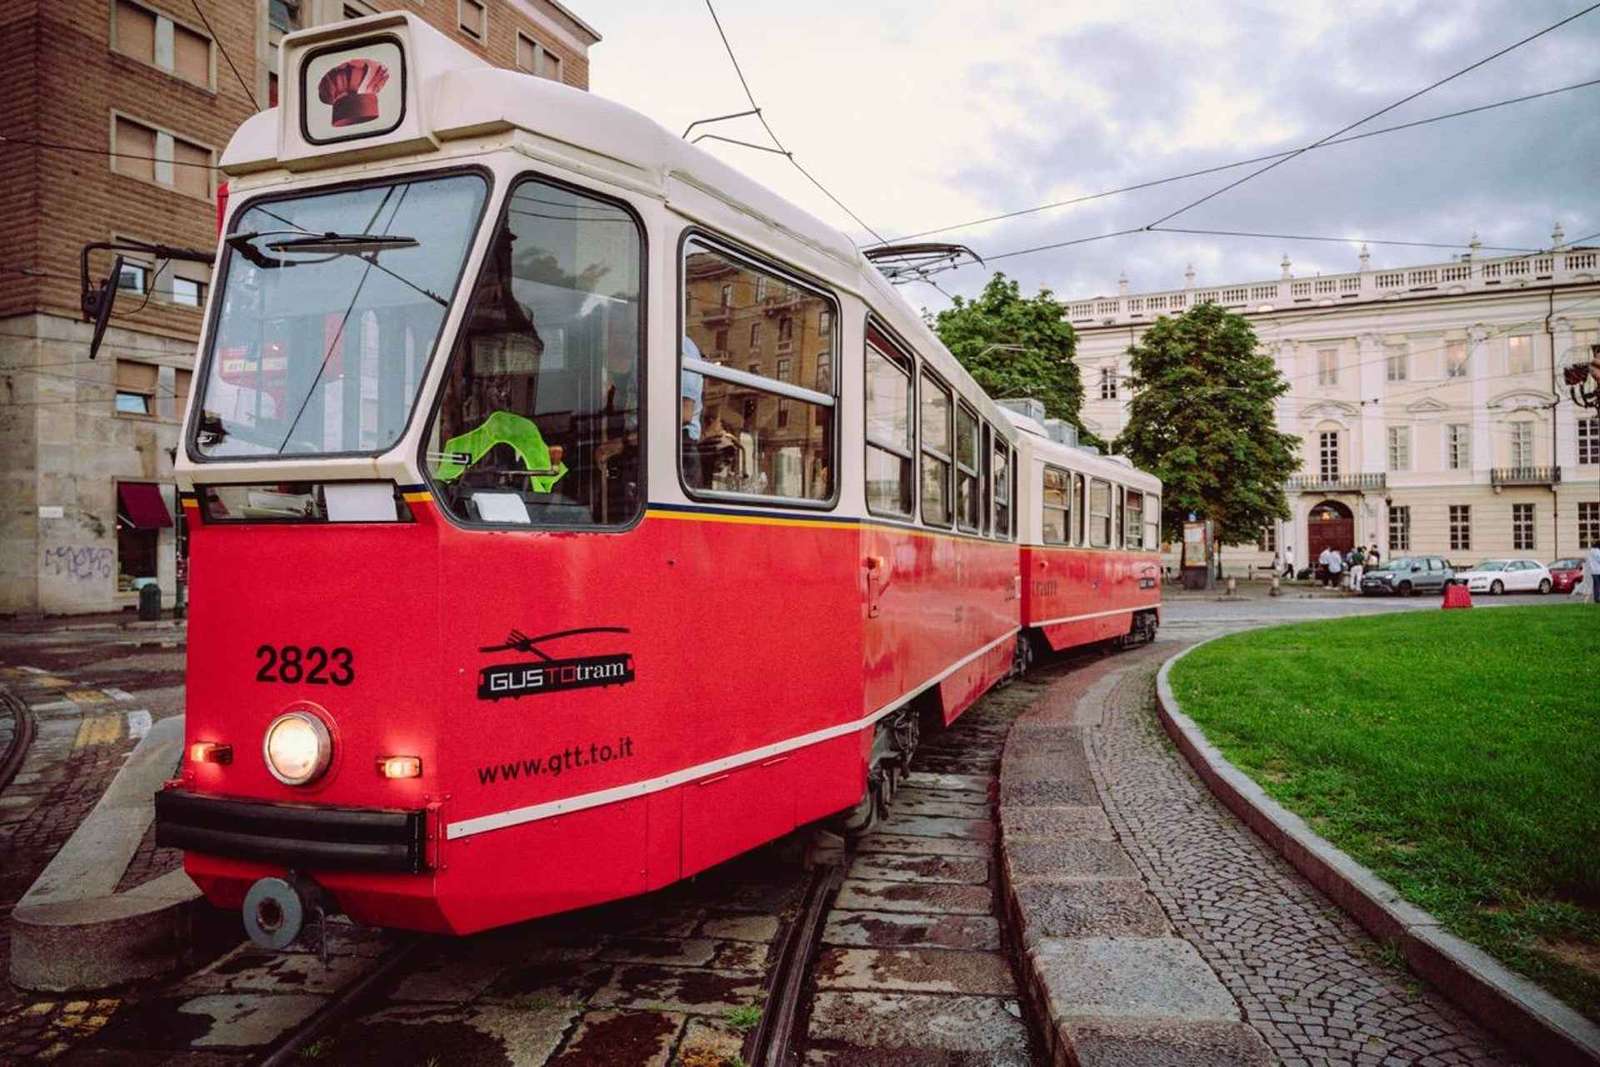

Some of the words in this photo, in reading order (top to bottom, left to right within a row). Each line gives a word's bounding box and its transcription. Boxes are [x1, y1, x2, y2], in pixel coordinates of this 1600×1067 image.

[256, 645, 355, 686] 2823
[490, 662, 625, 692] GUSTOtram
[477, 736, 634, 785] www.gtt.to.it
